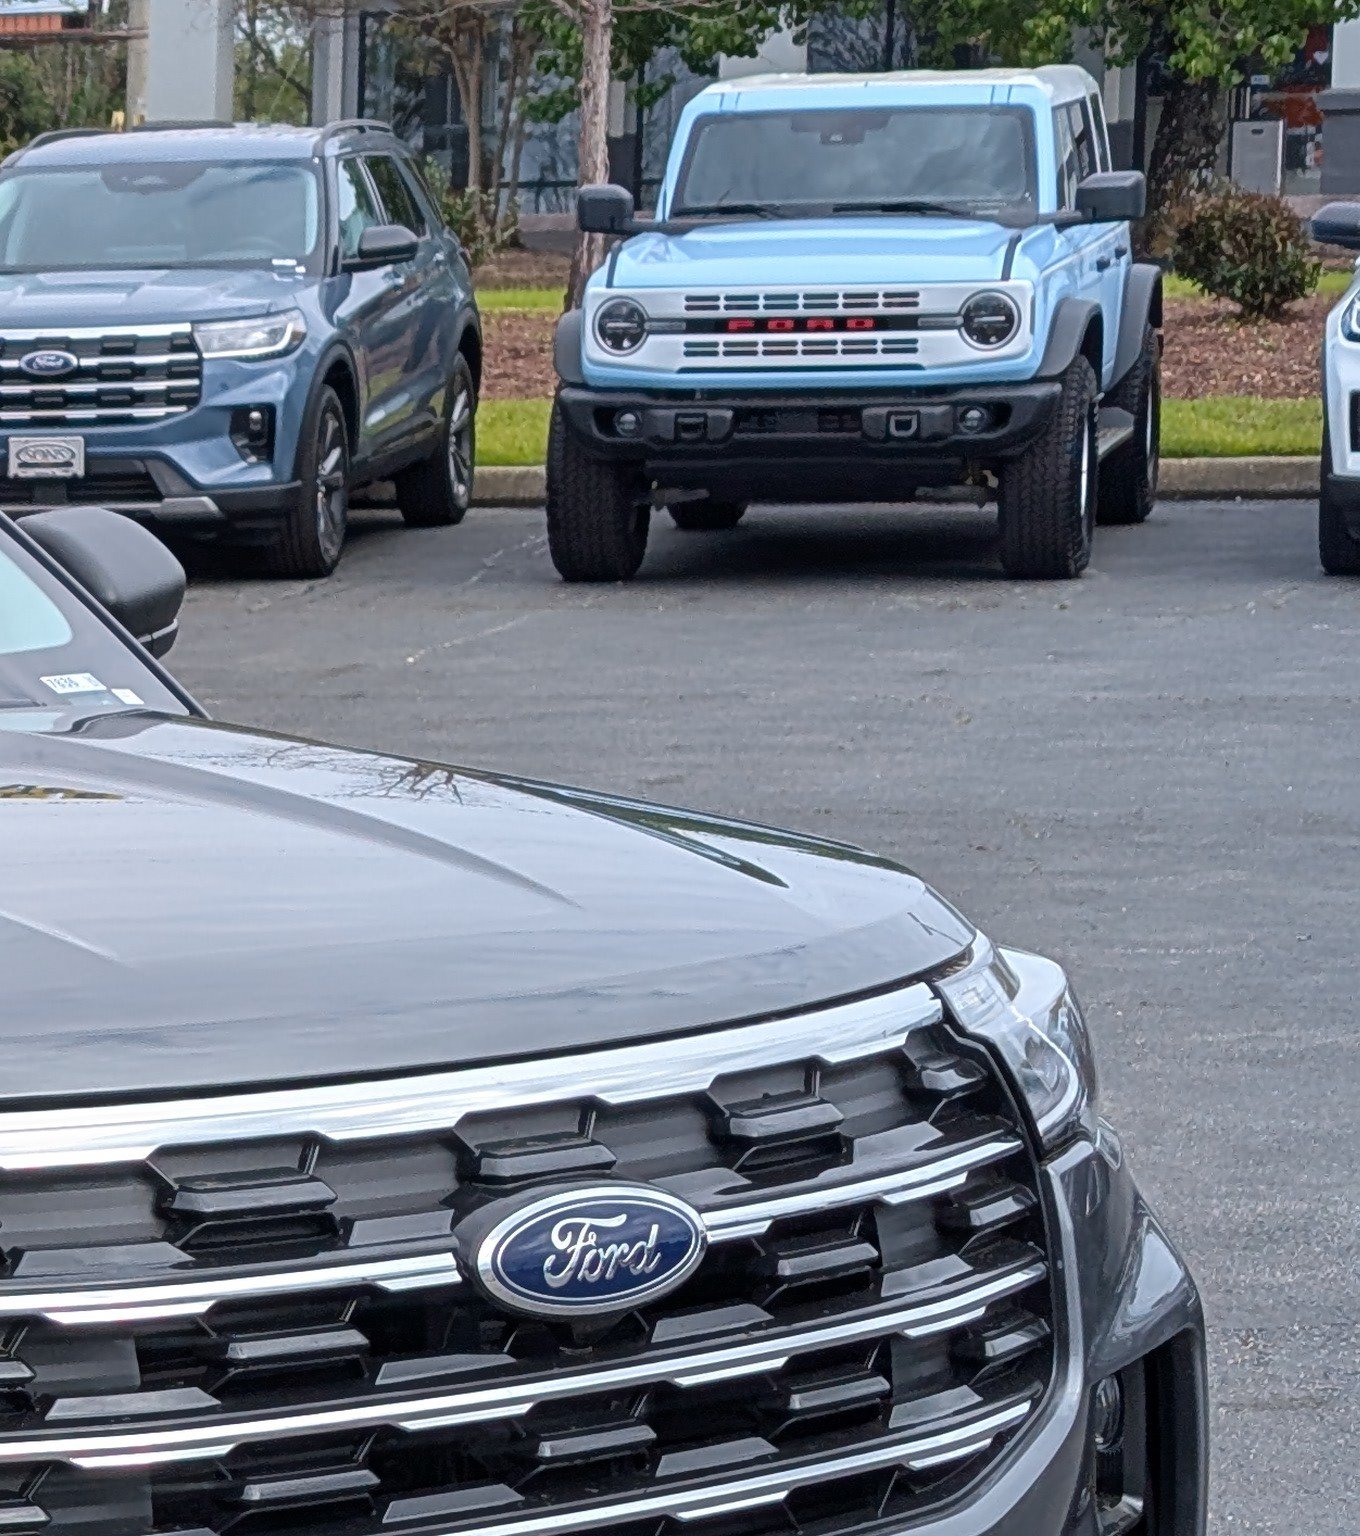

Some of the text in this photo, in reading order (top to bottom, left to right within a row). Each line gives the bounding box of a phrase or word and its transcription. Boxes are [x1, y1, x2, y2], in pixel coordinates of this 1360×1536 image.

[726, 317, 876, 332] FORD
[32, 354, 64, 370] Ford
[544, 1213, 662, 1288] Ford
